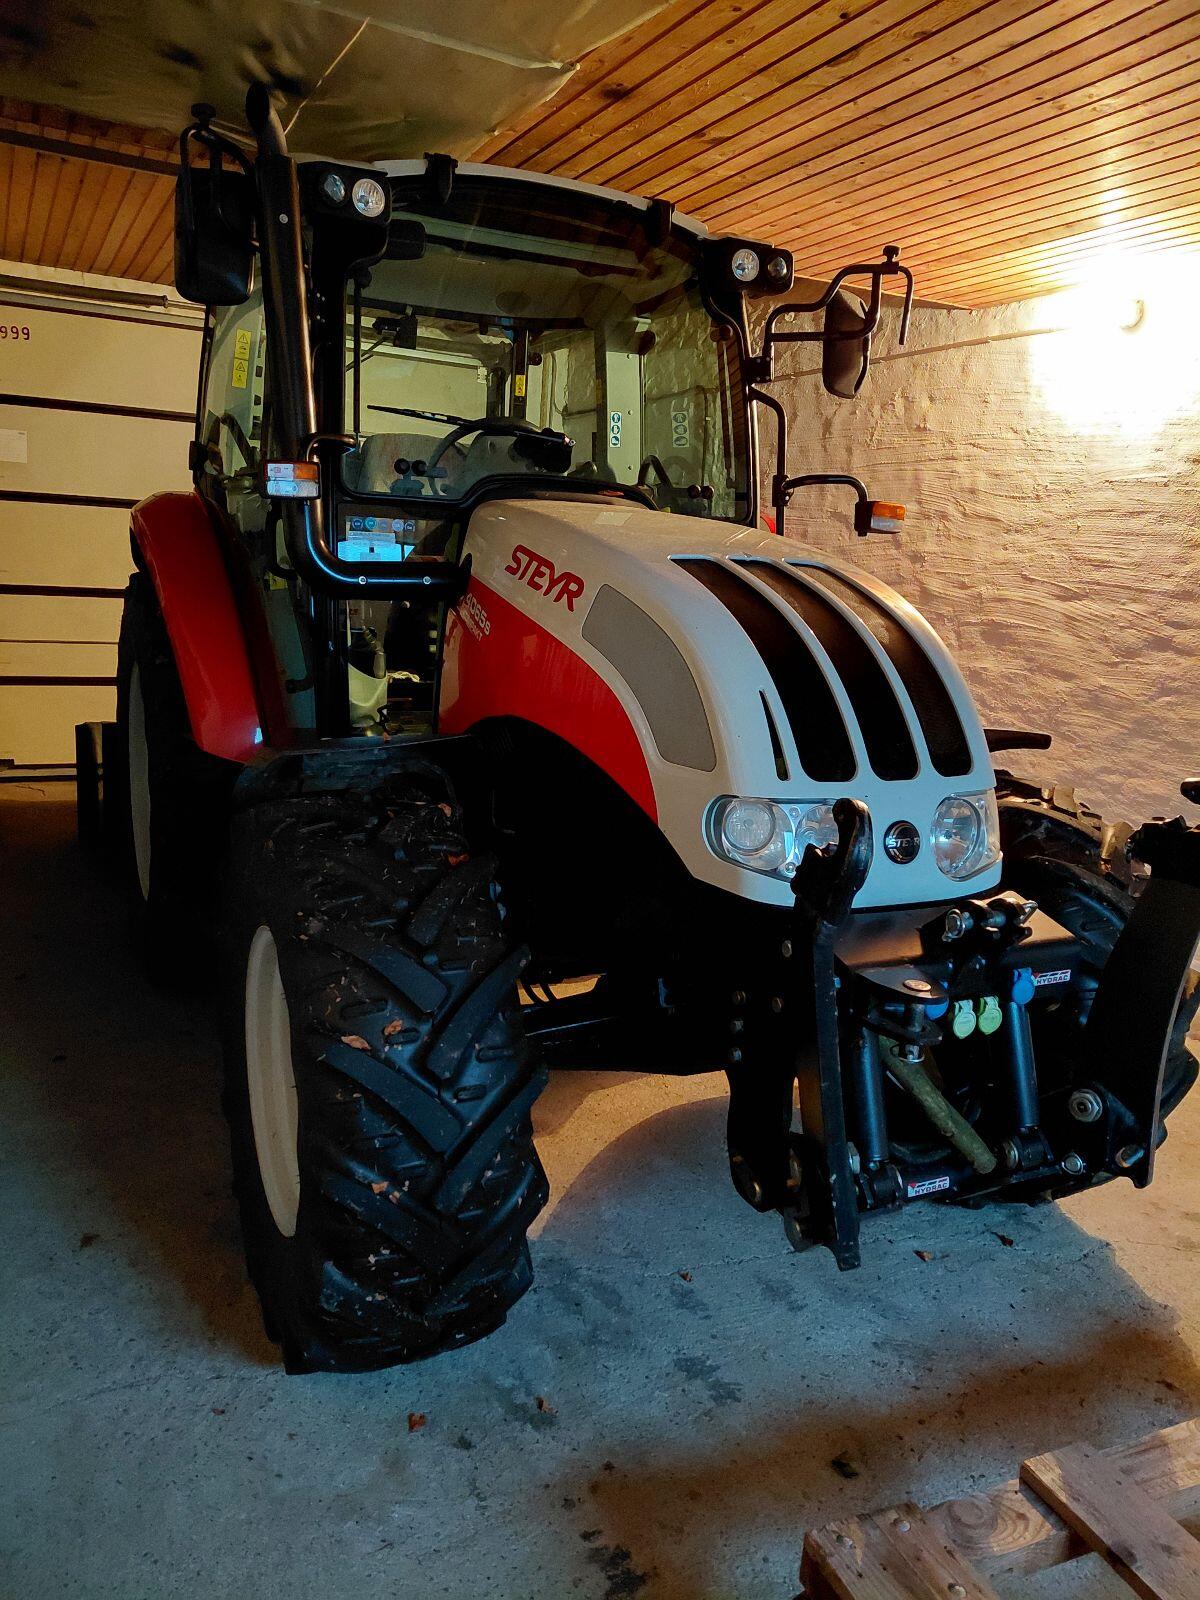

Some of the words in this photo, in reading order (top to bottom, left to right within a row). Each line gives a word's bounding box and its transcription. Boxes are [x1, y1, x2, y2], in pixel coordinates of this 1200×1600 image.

[504, 544, 585, 612] STEYR
[1036, 974, 1069, 986] HYDRAC
[915, 1182, 948, 1195] HYDRAC
